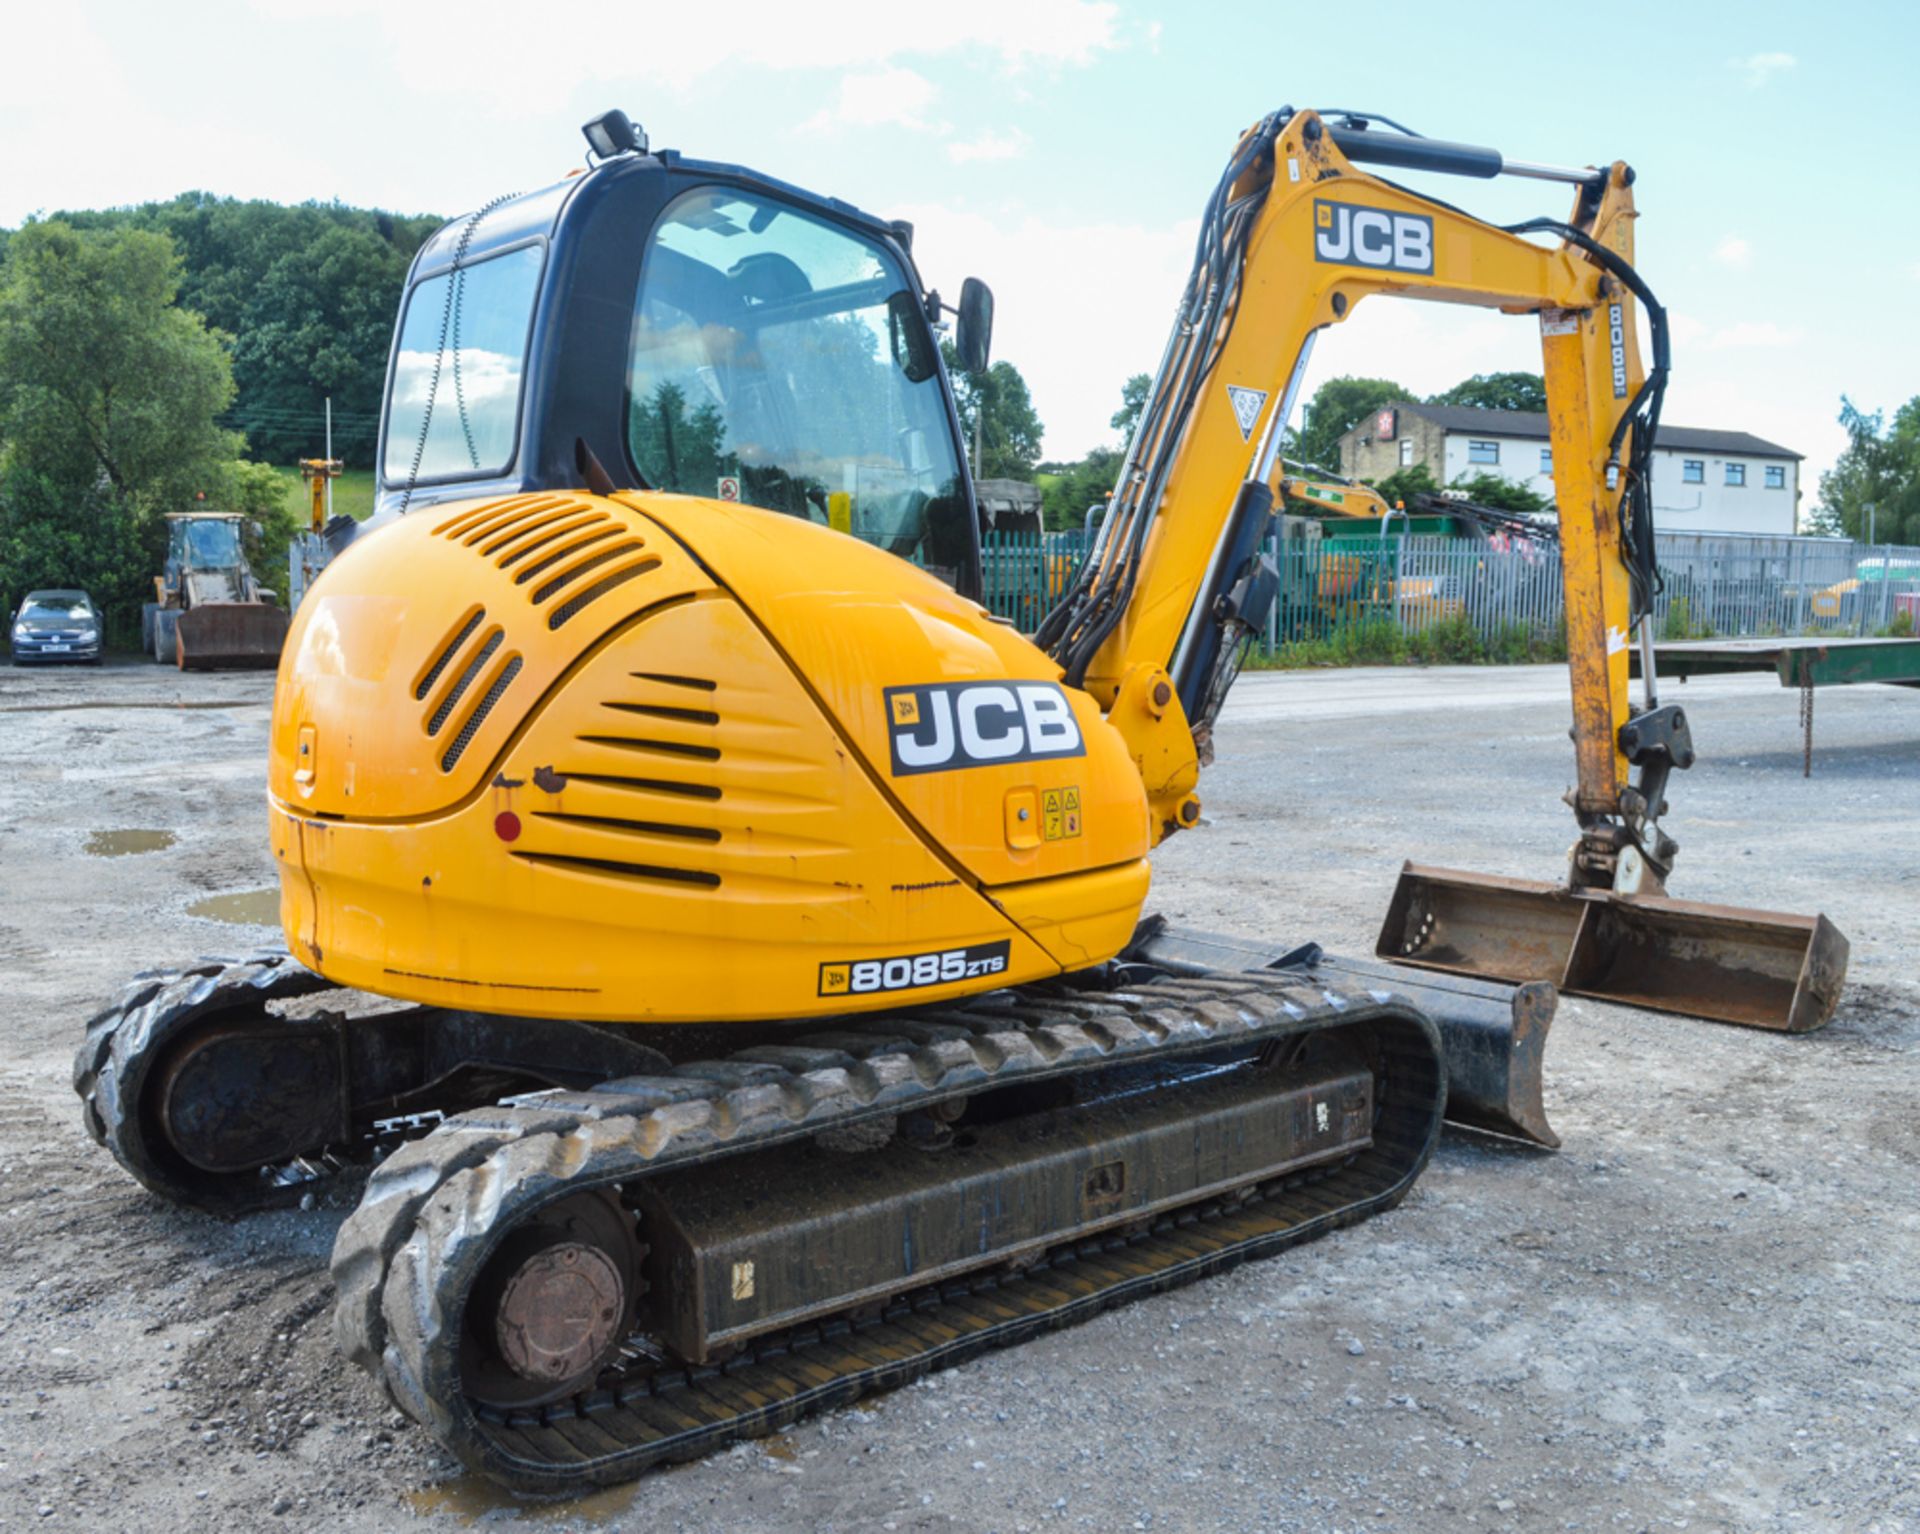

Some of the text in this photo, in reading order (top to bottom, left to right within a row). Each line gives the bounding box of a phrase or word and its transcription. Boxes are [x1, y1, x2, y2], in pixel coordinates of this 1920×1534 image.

[1316, 206, 1432, 270] JCB
[1610, 305, 1625, 387] 8085
[896, 686, 1080, 766] JCB
